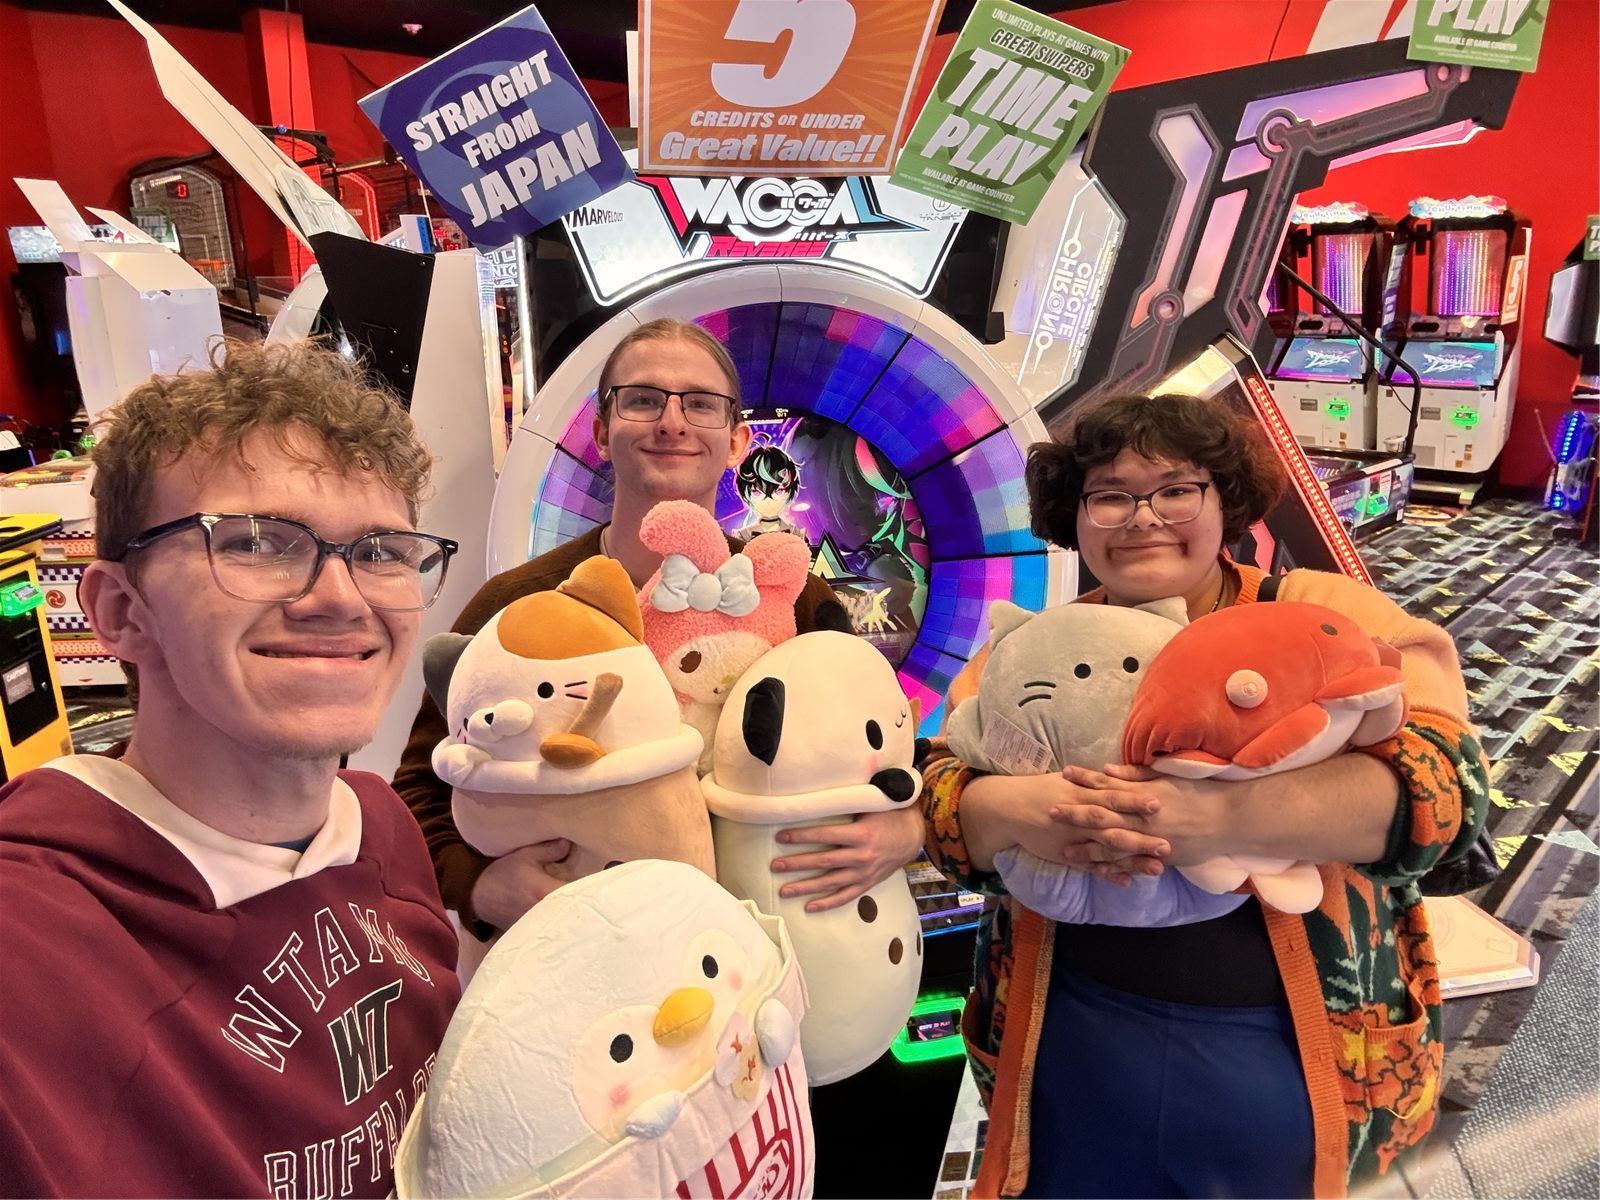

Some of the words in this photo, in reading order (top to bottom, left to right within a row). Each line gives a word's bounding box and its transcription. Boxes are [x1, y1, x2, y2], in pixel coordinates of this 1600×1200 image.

[711, 0, 857, 108] 5
[990, 28, 1036, 59] GREEN
[1034, 45, 1095, 80] SWIPERS
[991, 8, 1033, 32] UNLIMITED
[1032, 25, 1056, 41] PLAYS
[1055, 34, 1067, 45] AT
[1064, 38, 1091, 56] GAMES
[1089, 48, 1110, 63] WITH
[1427, 0, 1530, 35] PLAY
[405, 49, 552, 152] STRAIGHT
[690, 110, 775, 128] CREDITS
[778, 114, 797, 126] OR
[800, 113, 866, 130] UNDER
[946, 47, 1094, 141] TIME
[460, 122, 601, 228] JAPAN
[462, 108, 541, 169] FROM
[659, 131, 758, 161] Great
[760, 133, 886, 163] Value!!
[919, 113, 1052, 186] PLAY
[922, 166, 958, 187] AVAILABLE
[958, 179, 966, 188] AT
[965, 180, 986, 195] GAME
[984, 186, 1015, 204] COUNTER
[221, 902, 434, 1073] WTAMU
[328, 979, 403, 1106] WT
[264, 1052, 436, 1200] BUFFALO
